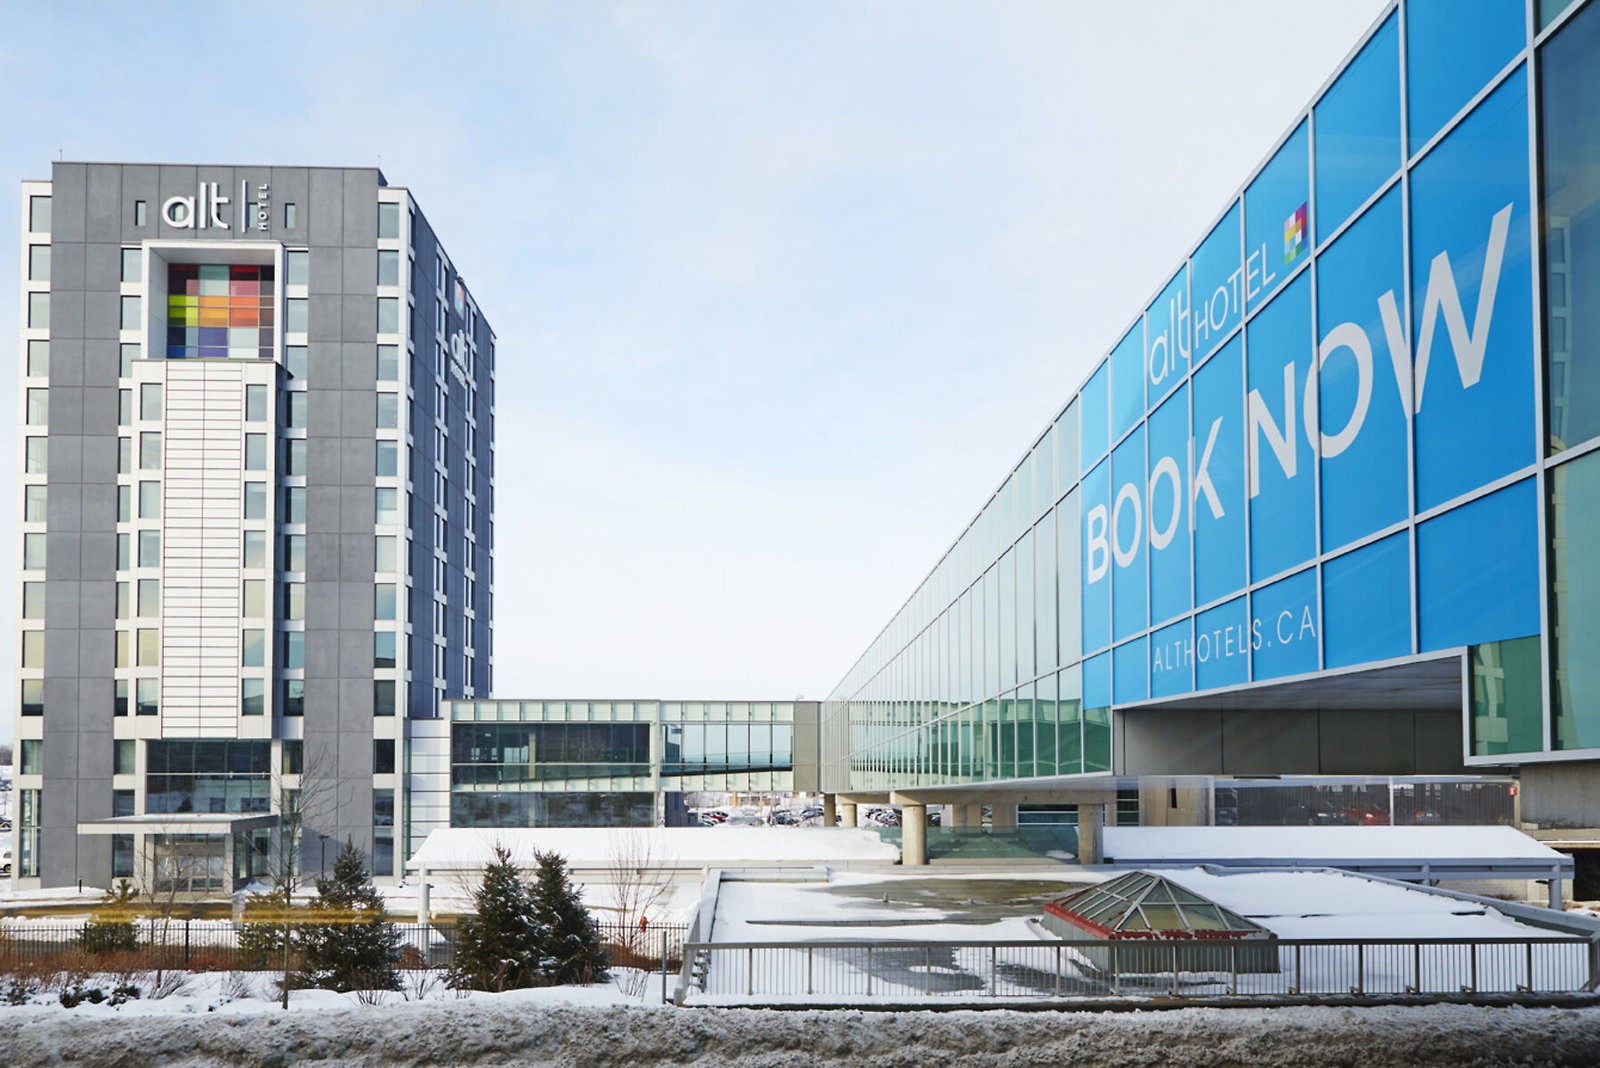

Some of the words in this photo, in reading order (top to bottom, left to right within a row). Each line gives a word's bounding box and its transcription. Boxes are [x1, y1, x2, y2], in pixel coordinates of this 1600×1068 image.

[162, 182, 229, 229] alt
[258, 183, 269, 231] HOTEL
[1087, 416, 1225, 585] BOOK
[1248, 202, 1514, 500] NOW
[1153, 606, 1316, 672] ALTHOTELS.CA
